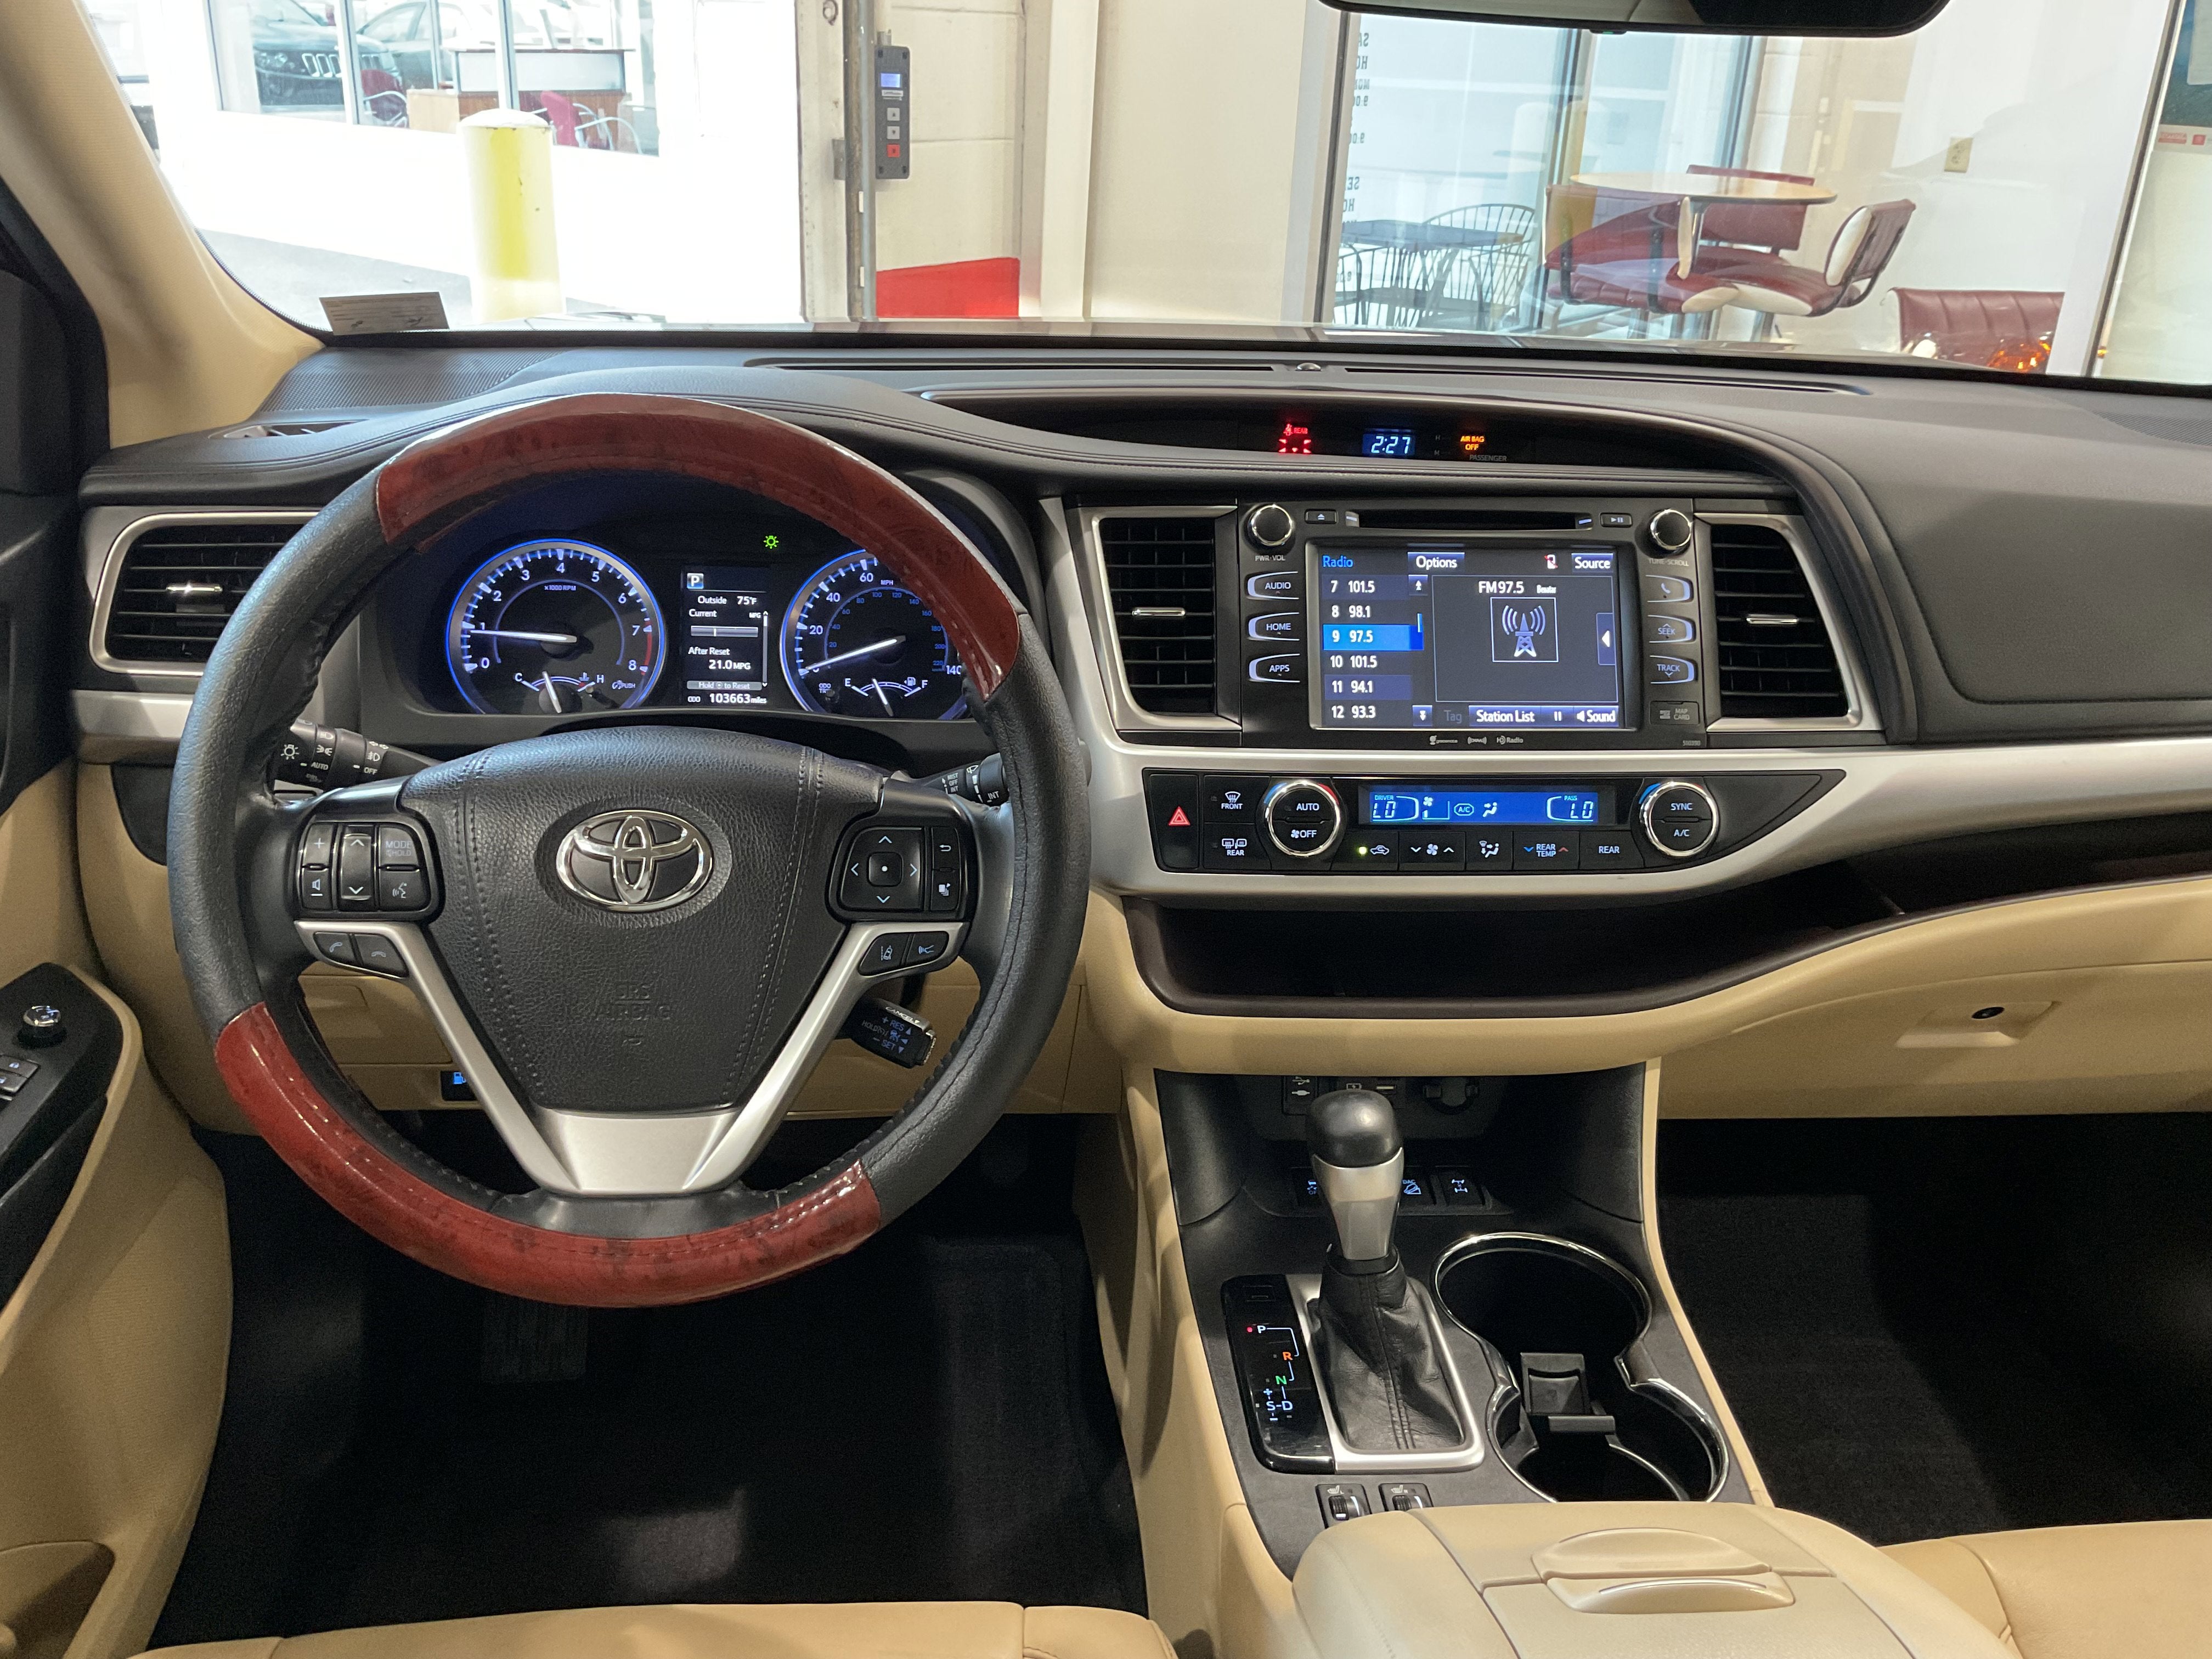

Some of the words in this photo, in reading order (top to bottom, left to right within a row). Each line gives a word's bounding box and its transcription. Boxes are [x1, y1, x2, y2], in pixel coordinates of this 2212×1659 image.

[1371, 436, 1410, 454] 2:27
[556, 562, 565, 573] 4
[1323, 555, 1354, 567] Radio
[1416, 556, 1458, 570] Options
[1575, 556, 1611, 569] Source
[521, 570, 529, 581] 3
[592, 572, 600, 582] 5
[691, 575, 699, 586] P
[860, 573, 873, 582] 60
[1330, 580, 1338, 593] 7
[1348, 580, 1375, 593] 101.5
[1498, 581, 1525, 594] 97.5
[493, 591, 502, 601] 2
[618, 593, 627, 604] 6
[697, 596, 727, 604] Outside
[826, 592, 840, 602] 40
[689, 609, 717, 618] Current
[1331, 605, 1339, 618] 8
[1348, 605, 1371, 618] 98.1
[480, 622, 485, 630] 1
[632, 625, 640, 636] 7
[809, 625, 823, 635] 20
[1266, 623, 1291, 631] HOME
[1332, 630, 1340, 642] 9
[1349, 630, 1374, 642] 97.5
[688, 647, 708, 655] After
[709, 647, 730, 656] Reset
[481, 658, 490, 668] 0
[628, 660, 636, 670] 8
[709, 659, 732, 670] 21.0
[1330, 655, 1343, 668] 10
[1350, 655, 1378, 668] 101.5
[1269, 664, 1290, 673] APPS
[1657, 664, 1680, 672] TRACK
[515, 673, 522, 682] C
[596, 674, 605, 683] H
[845, 678, 851, 686] E
[922, 680, 928, 689] F
[1332, 680, 1342, 693] 11
[1351, 680, 1373, 693] 94.1
[709, 693, 751, 704] 103663
[1331, 706, 1345, 719] 12
[1351, 706, 1376, 719] 93.3
[1444, 709, 1462, 724] Tag
[1476, 709, 1514, 723] Station
[1515, 710, 1535, 723] List
[1587, 710, 1616, 723] Sound
[311, 762, 329, 770] AUTO
[364, 767, 377, 775] OFF
[988, 791, 999, 800] INT
[1671, 803, 1693, 811] SYNC
[1300, 830, 1317, 838] OFF
[385, 840, 413, 849] MODE
[885, 1007, 913, 1022] CANCEL
[889, 1019, 905, 1031] RES
[881, 1039, 896, 1051] SET
[1257, 1325, 1266, 1334] P
[1283, 1352, 1293, 1361] R
[1275, 1375, 1287, 1385] N
